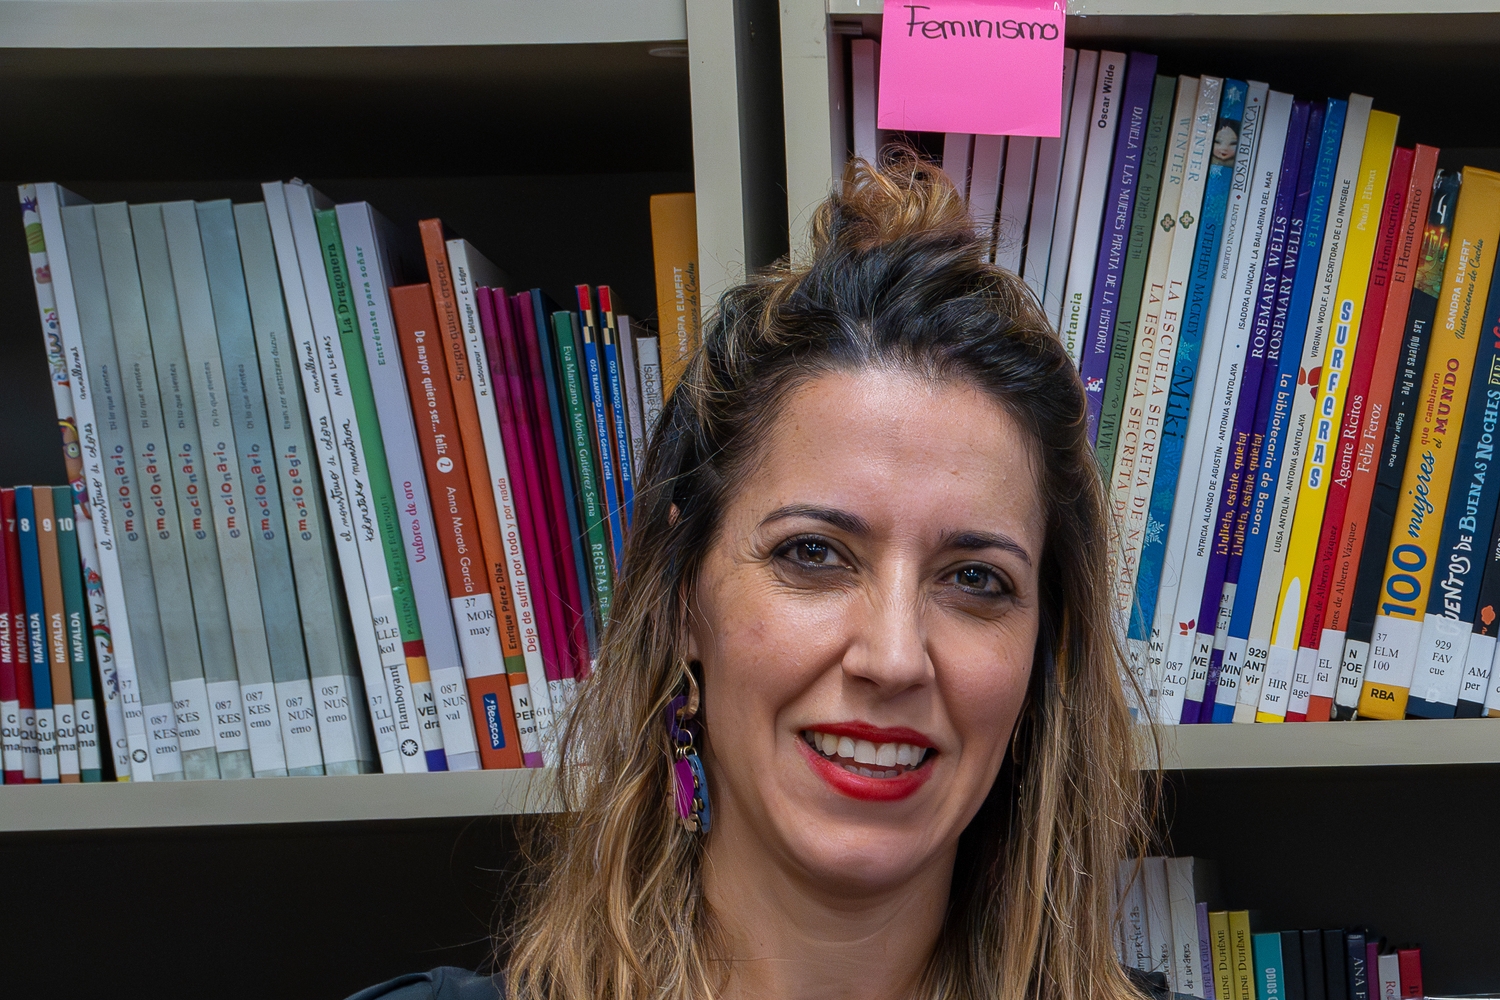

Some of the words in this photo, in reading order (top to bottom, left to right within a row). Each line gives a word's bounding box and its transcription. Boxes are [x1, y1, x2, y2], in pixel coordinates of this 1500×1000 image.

[904, 5, 1059, 40] Feminismo
[1103, 64, 1116, 94] Wilde
[1097, 97, 1111, 128] Oscar
[356, 246, 368, 277] soñar
[364, 282, 376, 307] para
[1167, 280, 1182, 300] LA
[1252, 273, 1277, 358] ROSEMARY
[1269, 216, 1288, 270] WELLS
[1446, 286, 1462, 330] SANDRA
[1457, 239, 1471, 283] ELMERT
[370, 311, 385, 365] Entrénate
[414, 331, 425, 343] De
[417, 346, 430, 373] mayor
[1152, 310, 1177, 396] ESCUELA
[422, 377, 436, 407] quiero
[1279, 373, 1292, 388] La
[1162, 366, 1193, 439] Miki
[1424, 372, 1440, 423] cambiaron
[1434, 358, 1460, 435] MUNDO
[1264, 390, 1290, 470] bibliotecaria
[1363, 403, 1382, 437] Feroz
[434, 434, 446, 454] feliz
[1136, 404, 1161, 487] SECRETA
[1334, 443, 1354, 489] Agente
[1344, 395, 1363, 439] Ricitos
[1421, 427, 1430, 445] que
[1434, 439, 1442, 449] el
[1357, 438, 1374, 473] Feliz
[1459, 461, 1487, 533] BUENAS
[1476, 389, 1500, 461] NOCHES
[111, 445, 139, 541] emocionario
[213, 442, 240, 539] emocionario
[285, 445, 312, 540] emoziotegia
[403, 481, 414, 499] oro
[498, 478, 508, 501] nada
[1260, 472, 1273, 488] de
[405, 502, 418, 516] de
[504, 504, 514, 520] por
[1252, 492, 1269, 535] Basora
[58, 518, 73, 531] 10
[1381, 544, 1428, 616] 100
[1407, 450, 1435, 538] mujeres
[410, 519, 427, 563] Valores
[446, 487, 458, 513] Anna
[452, 517, 466, 554] Morató
[460, 556, 473, 593] García
[507, 531, 518, 555] todo
[514, 560, 525, 576] por
[465, 599, 476, 608] 37
[515, 580, 528, 608] sufrir
[467, 610, 494, 622] MOR
[470, 626, 491, 636] may
[522, 611, 531, 624] de
[52, 613, 65, 663] MAFALDA
[70, 612, 83, 662] MAFALDA
[527, 628, 538, 652] Deje
[246, 692, 263, 701] 087
[248, 704, 270, 715] KES
[392, 665, 410, 730] Flamboyant
[250, 719, 271, 728] emo
[1354, 957, 1365, 993] ANA
